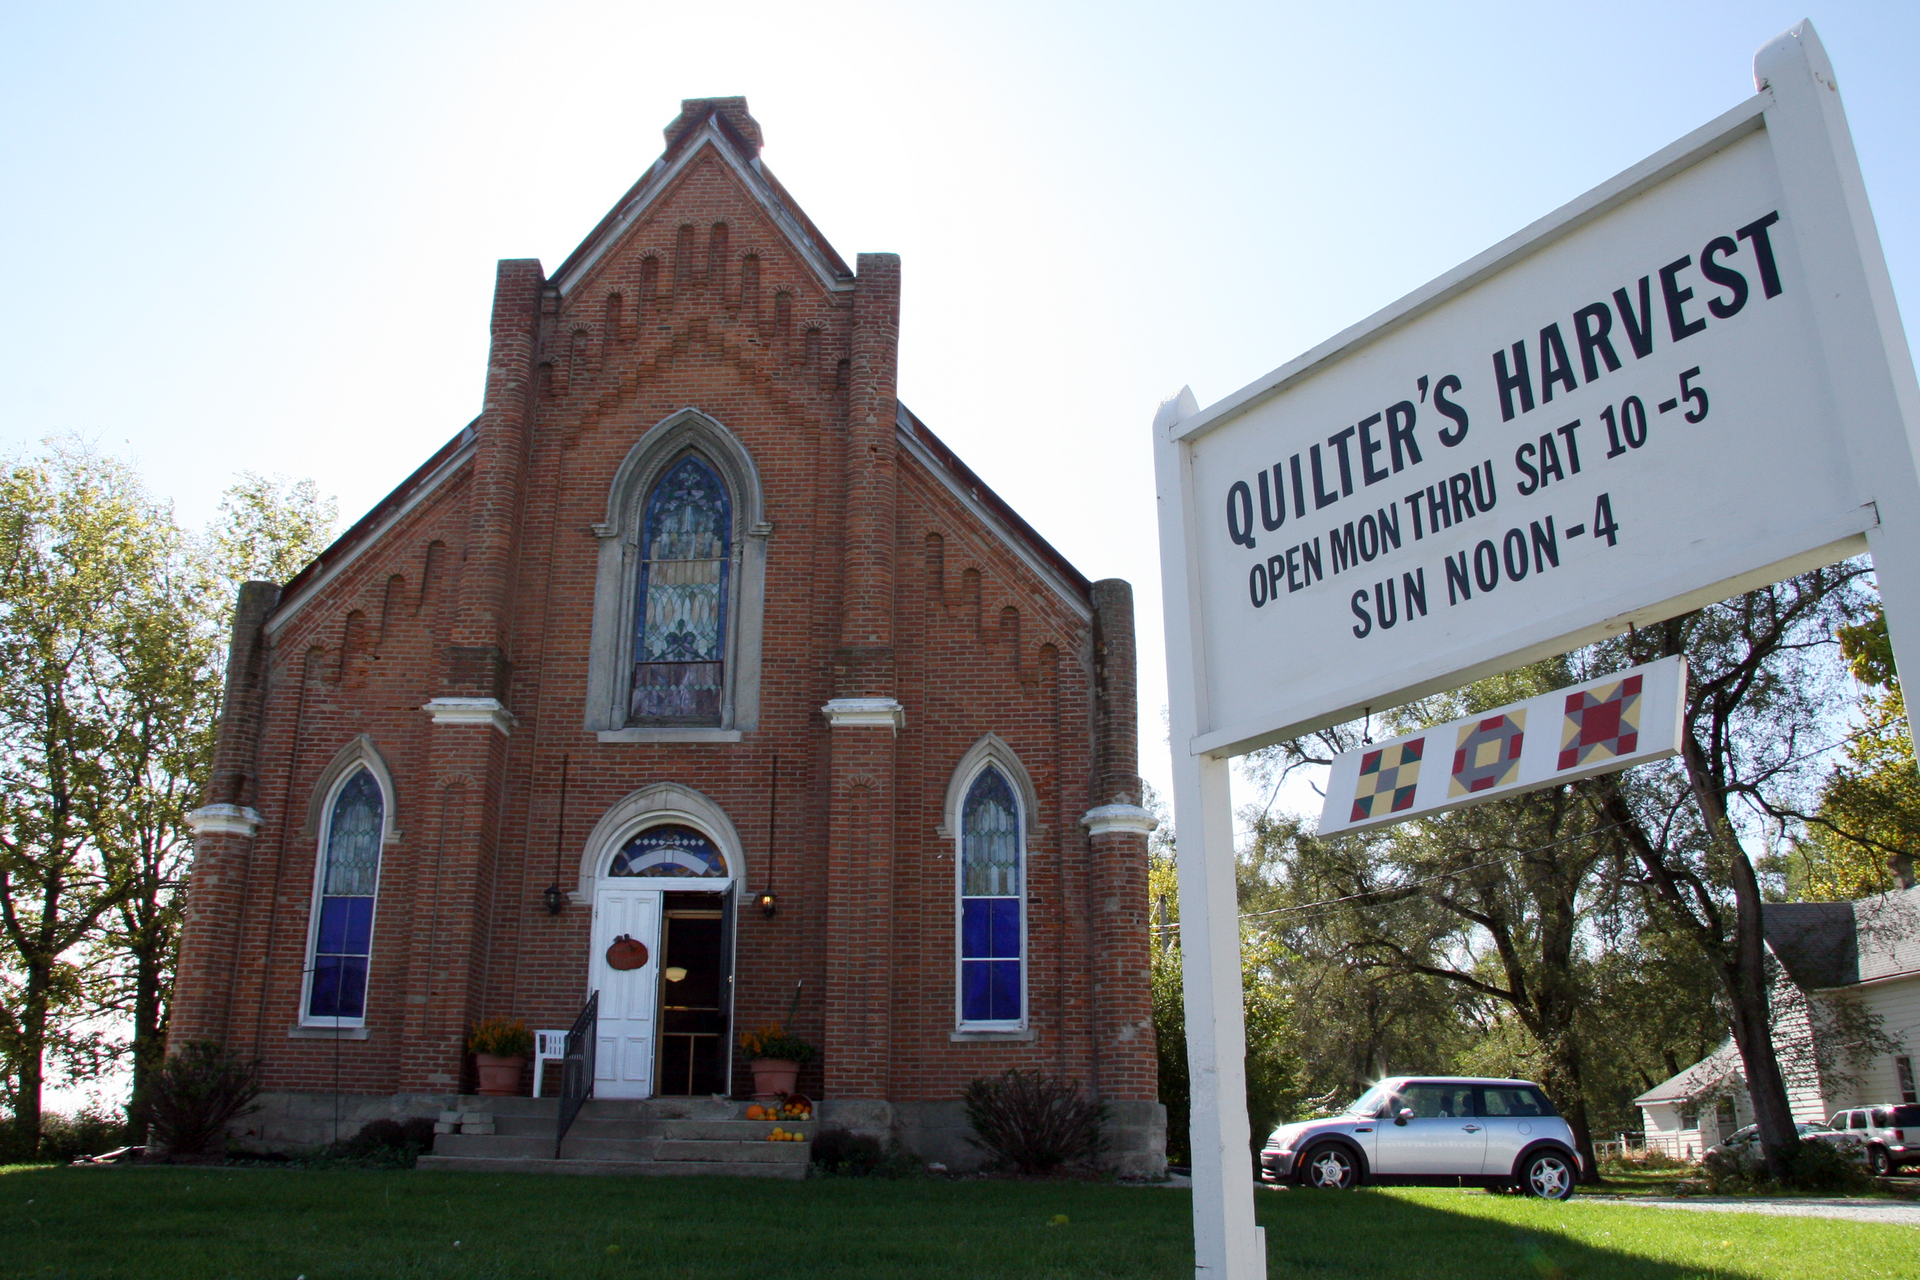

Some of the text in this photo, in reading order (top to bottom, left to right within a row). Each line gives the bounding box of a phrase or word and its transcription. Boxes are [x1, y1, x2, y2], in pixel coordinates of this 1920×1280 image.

[1226, 209, 1783, 549] QUILTER'S HARVEST
[1249, 536, 1323, 609] OPEN
[1329, 501, 1402, 575] MON
[1404, 459, 1497, 541] THRU
[1515, 418, 1582, 496] SAT
[1350, 566, 1428, 639] SUN
